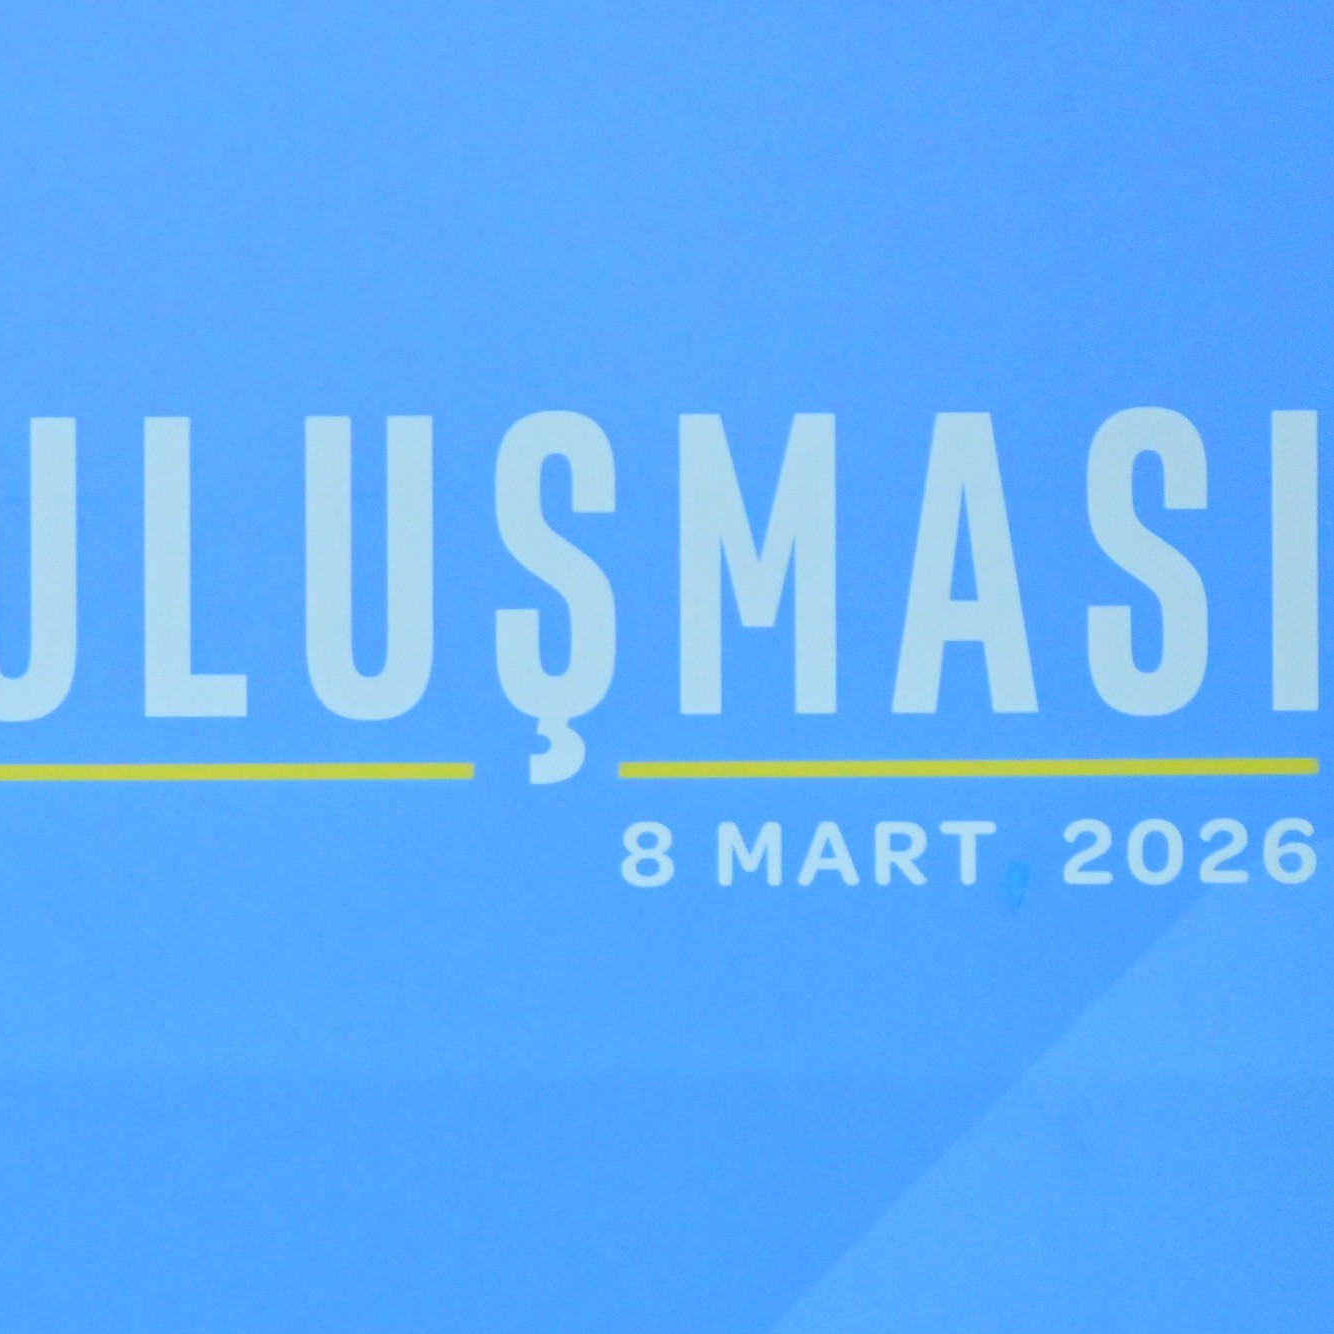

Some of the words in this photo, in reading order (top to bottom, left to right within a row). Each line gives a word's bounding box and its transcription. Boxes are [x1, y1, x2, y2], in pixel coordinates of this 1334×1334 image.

[621, 820, 675, 888] 8
[717, 820, 997, 887] MART
[1063, 817, 1318, 886] 2026
